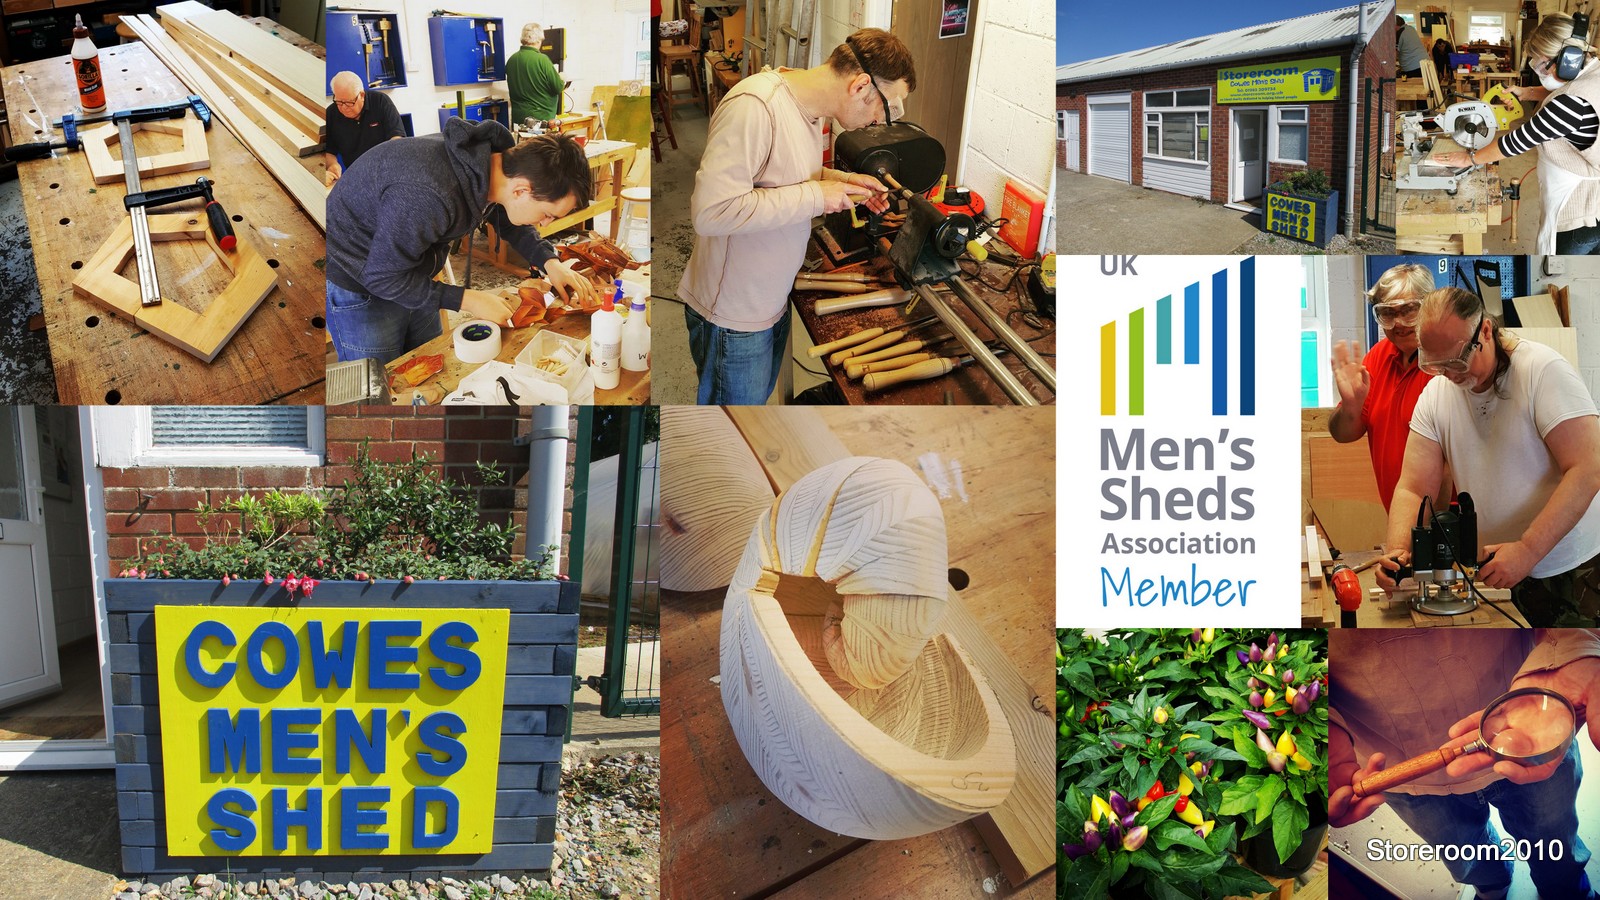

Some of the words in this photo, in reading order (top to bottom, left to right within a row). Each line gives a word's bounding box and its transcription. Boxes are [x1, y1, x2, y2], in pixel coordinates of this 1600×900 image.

[1223, 67, 1298, 80] Storeroom
[1270, 197, 1310, 215] COWES
[1271, 220, 1308, 239] SHED
[1100, 255, 1138, 276] UK
[1440, 260, 1446, 272] 9
[1100, 428, 1255, 471] Men's
[1100, 475, 1255, 521] Sheds
[1100, 532, 1256, 554] Association
[1100, 562, 1257, 607] Member
[184, 620, 482, 691] COWES
[207, 708, 468, 777] MEN'S
[206, 786, 460, 851] SHED
